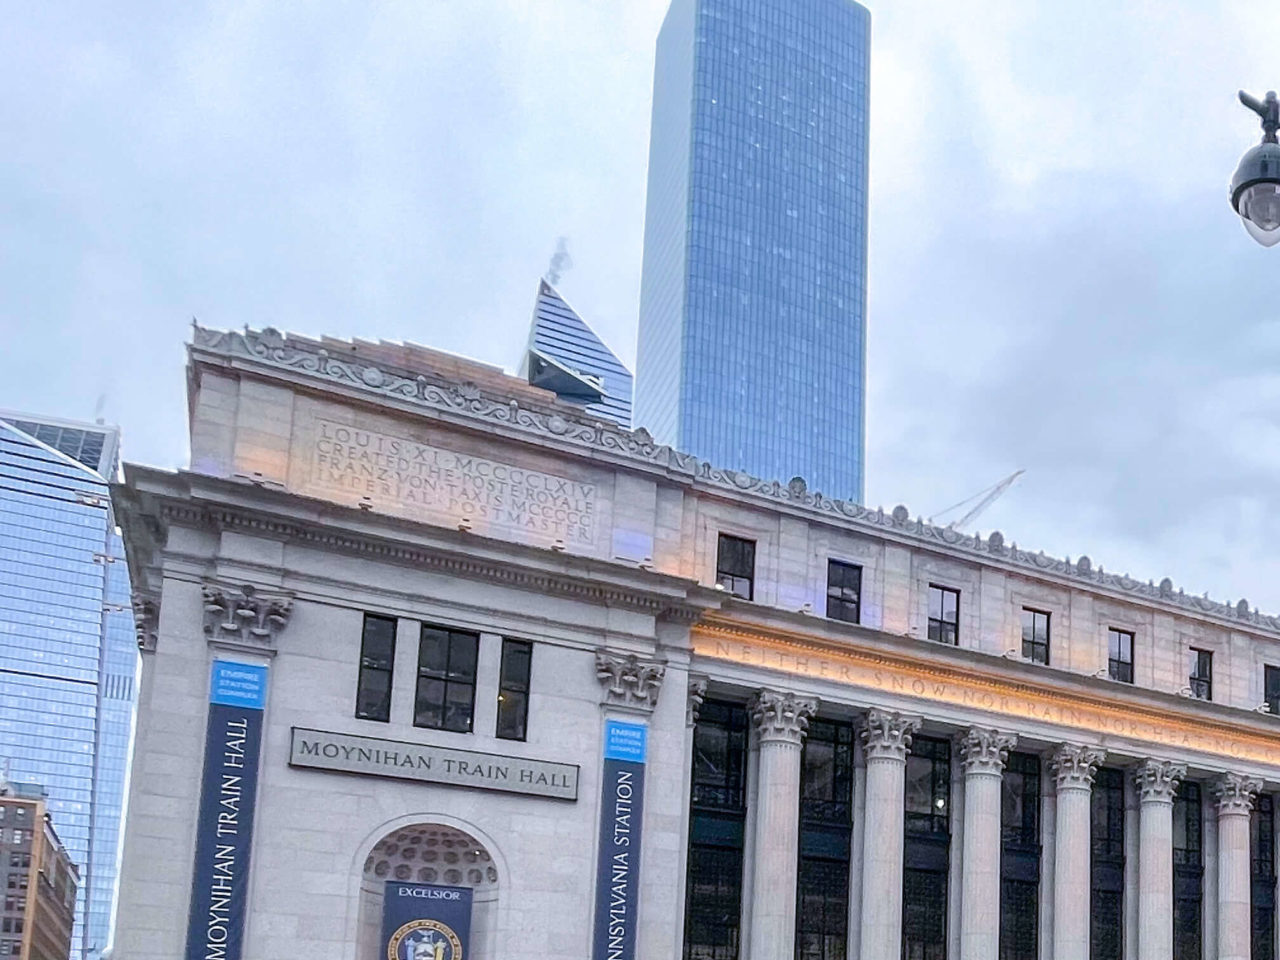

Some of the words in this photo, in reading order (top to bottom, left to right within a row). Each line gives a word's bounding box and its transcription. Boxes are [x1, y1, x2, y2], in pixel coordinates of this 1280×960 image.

[317, 439, 410, 472] CREATED
[414, 461, 455, 483] THE
[462, 472, 523, 498] POSTE
[525, 487, 593, 515] ROYALE
[317, 454, 389, 482] FRANZ
[394, 471, 438, 491] VON
[446, 483, 503, 508] TAXIS
[321, 424, 401, 456] LOUIS
[414, 447, 440, 464] XI
[454, 455, 596, 498] MCCCCLXIV
[317, 468, 432, 506] IMPERIAL
[448, 499, 589, 540] POSTMASTER
[219, 679, 259, 691] STATION
[715, 640, 855, 680] NEITHER
[873, 673, 947, 698] SNOW
[962, 689, 1012, 712] NOR
[1026, 703, 1082, 724] RAIN
[1096, 717, 1138, 735] NOR
[223, 717, 248, 769] HALL
[300, 740, 433, 771] MOYNIHAN
[443, 759, 510, 780] TRAIN
[518, 769, 571, 789] HALL
[217, 774, 242, 838] TRAIN
[613, 770, 633, 847] STATION
[398, 887, 461, 901] EXCELSIOR
